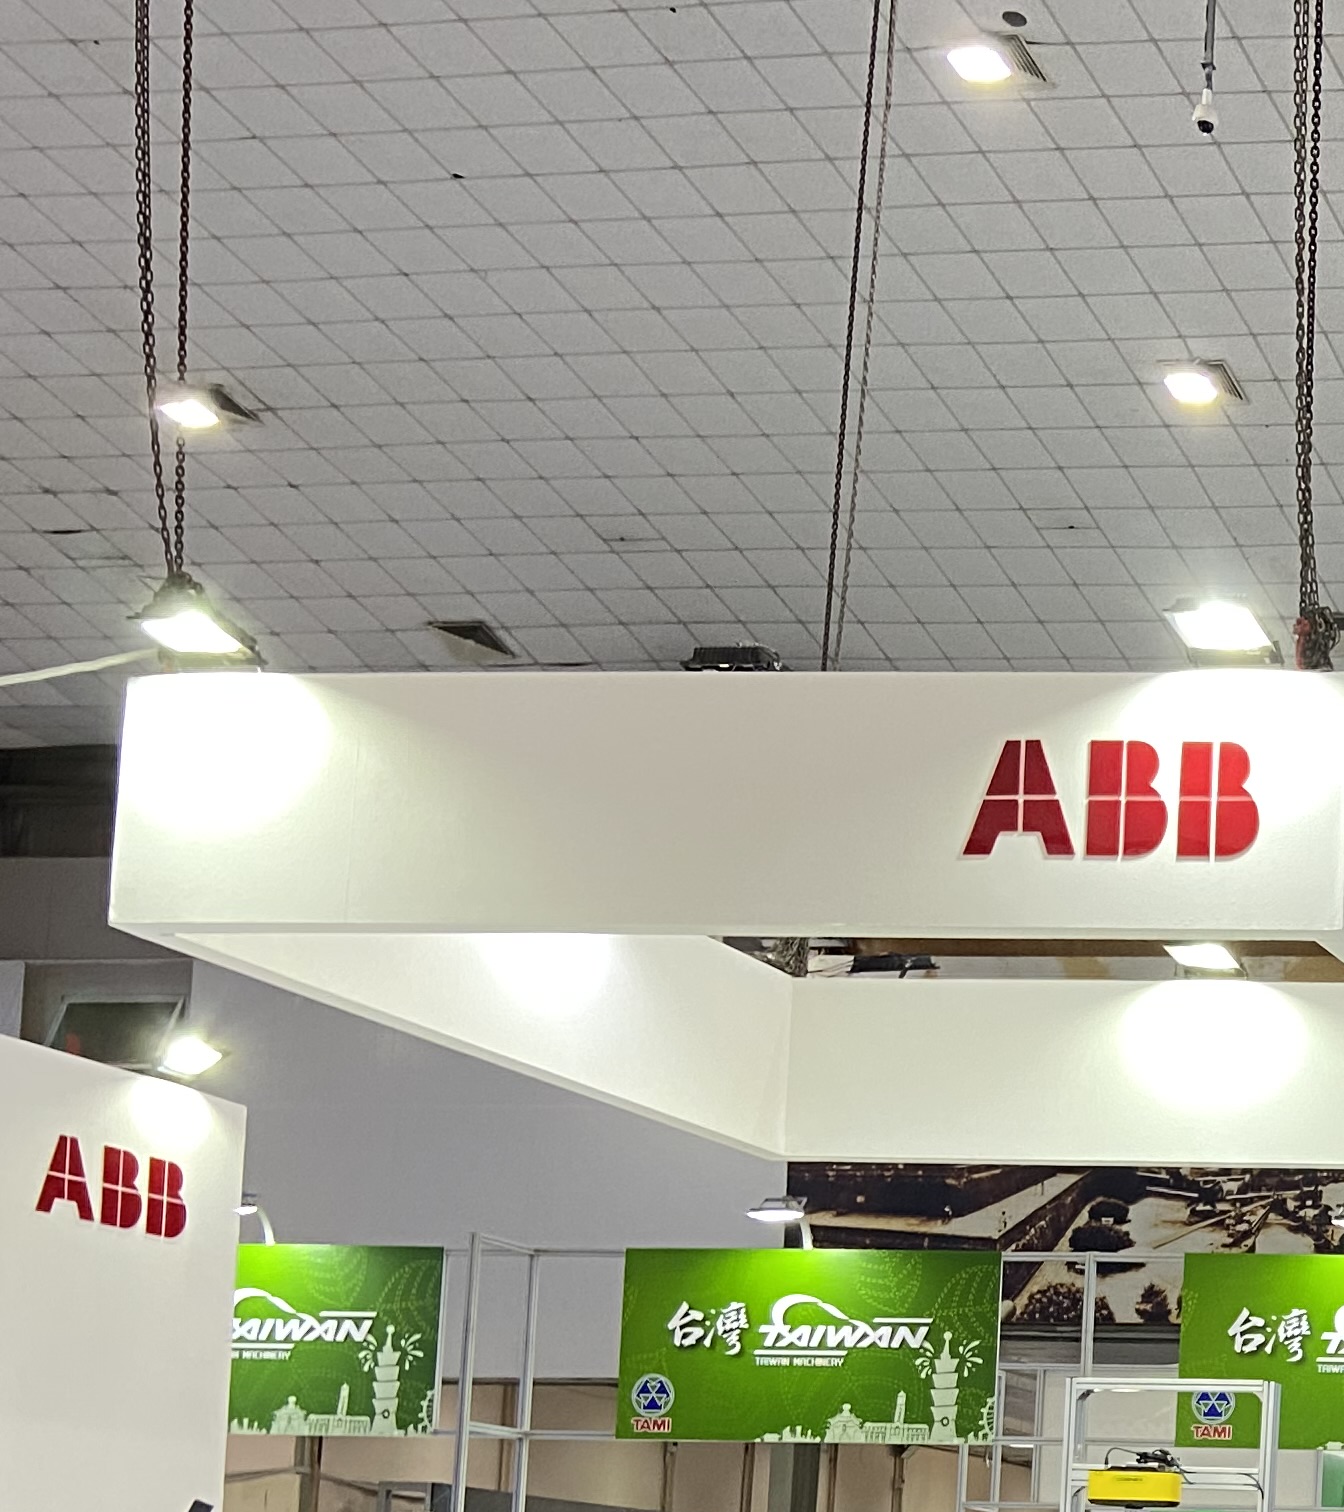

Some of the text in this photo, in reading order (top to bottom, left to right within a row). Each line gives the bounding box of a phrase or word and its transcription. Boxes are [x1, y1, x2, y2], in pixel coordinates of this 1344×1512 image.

[963, 739, 1260, 860] ABB
[35, 1134, 187, 1239] ABB
[667, 1301, 750, 1356] 台灣
[758, 1309, 932, 1349] TAIWAN
[1227, 1306, 1312, 1362] 台灣
[631, 1417, 672, 1433] TAMI
[1191, 1424, 1233, 1440] TAMI
